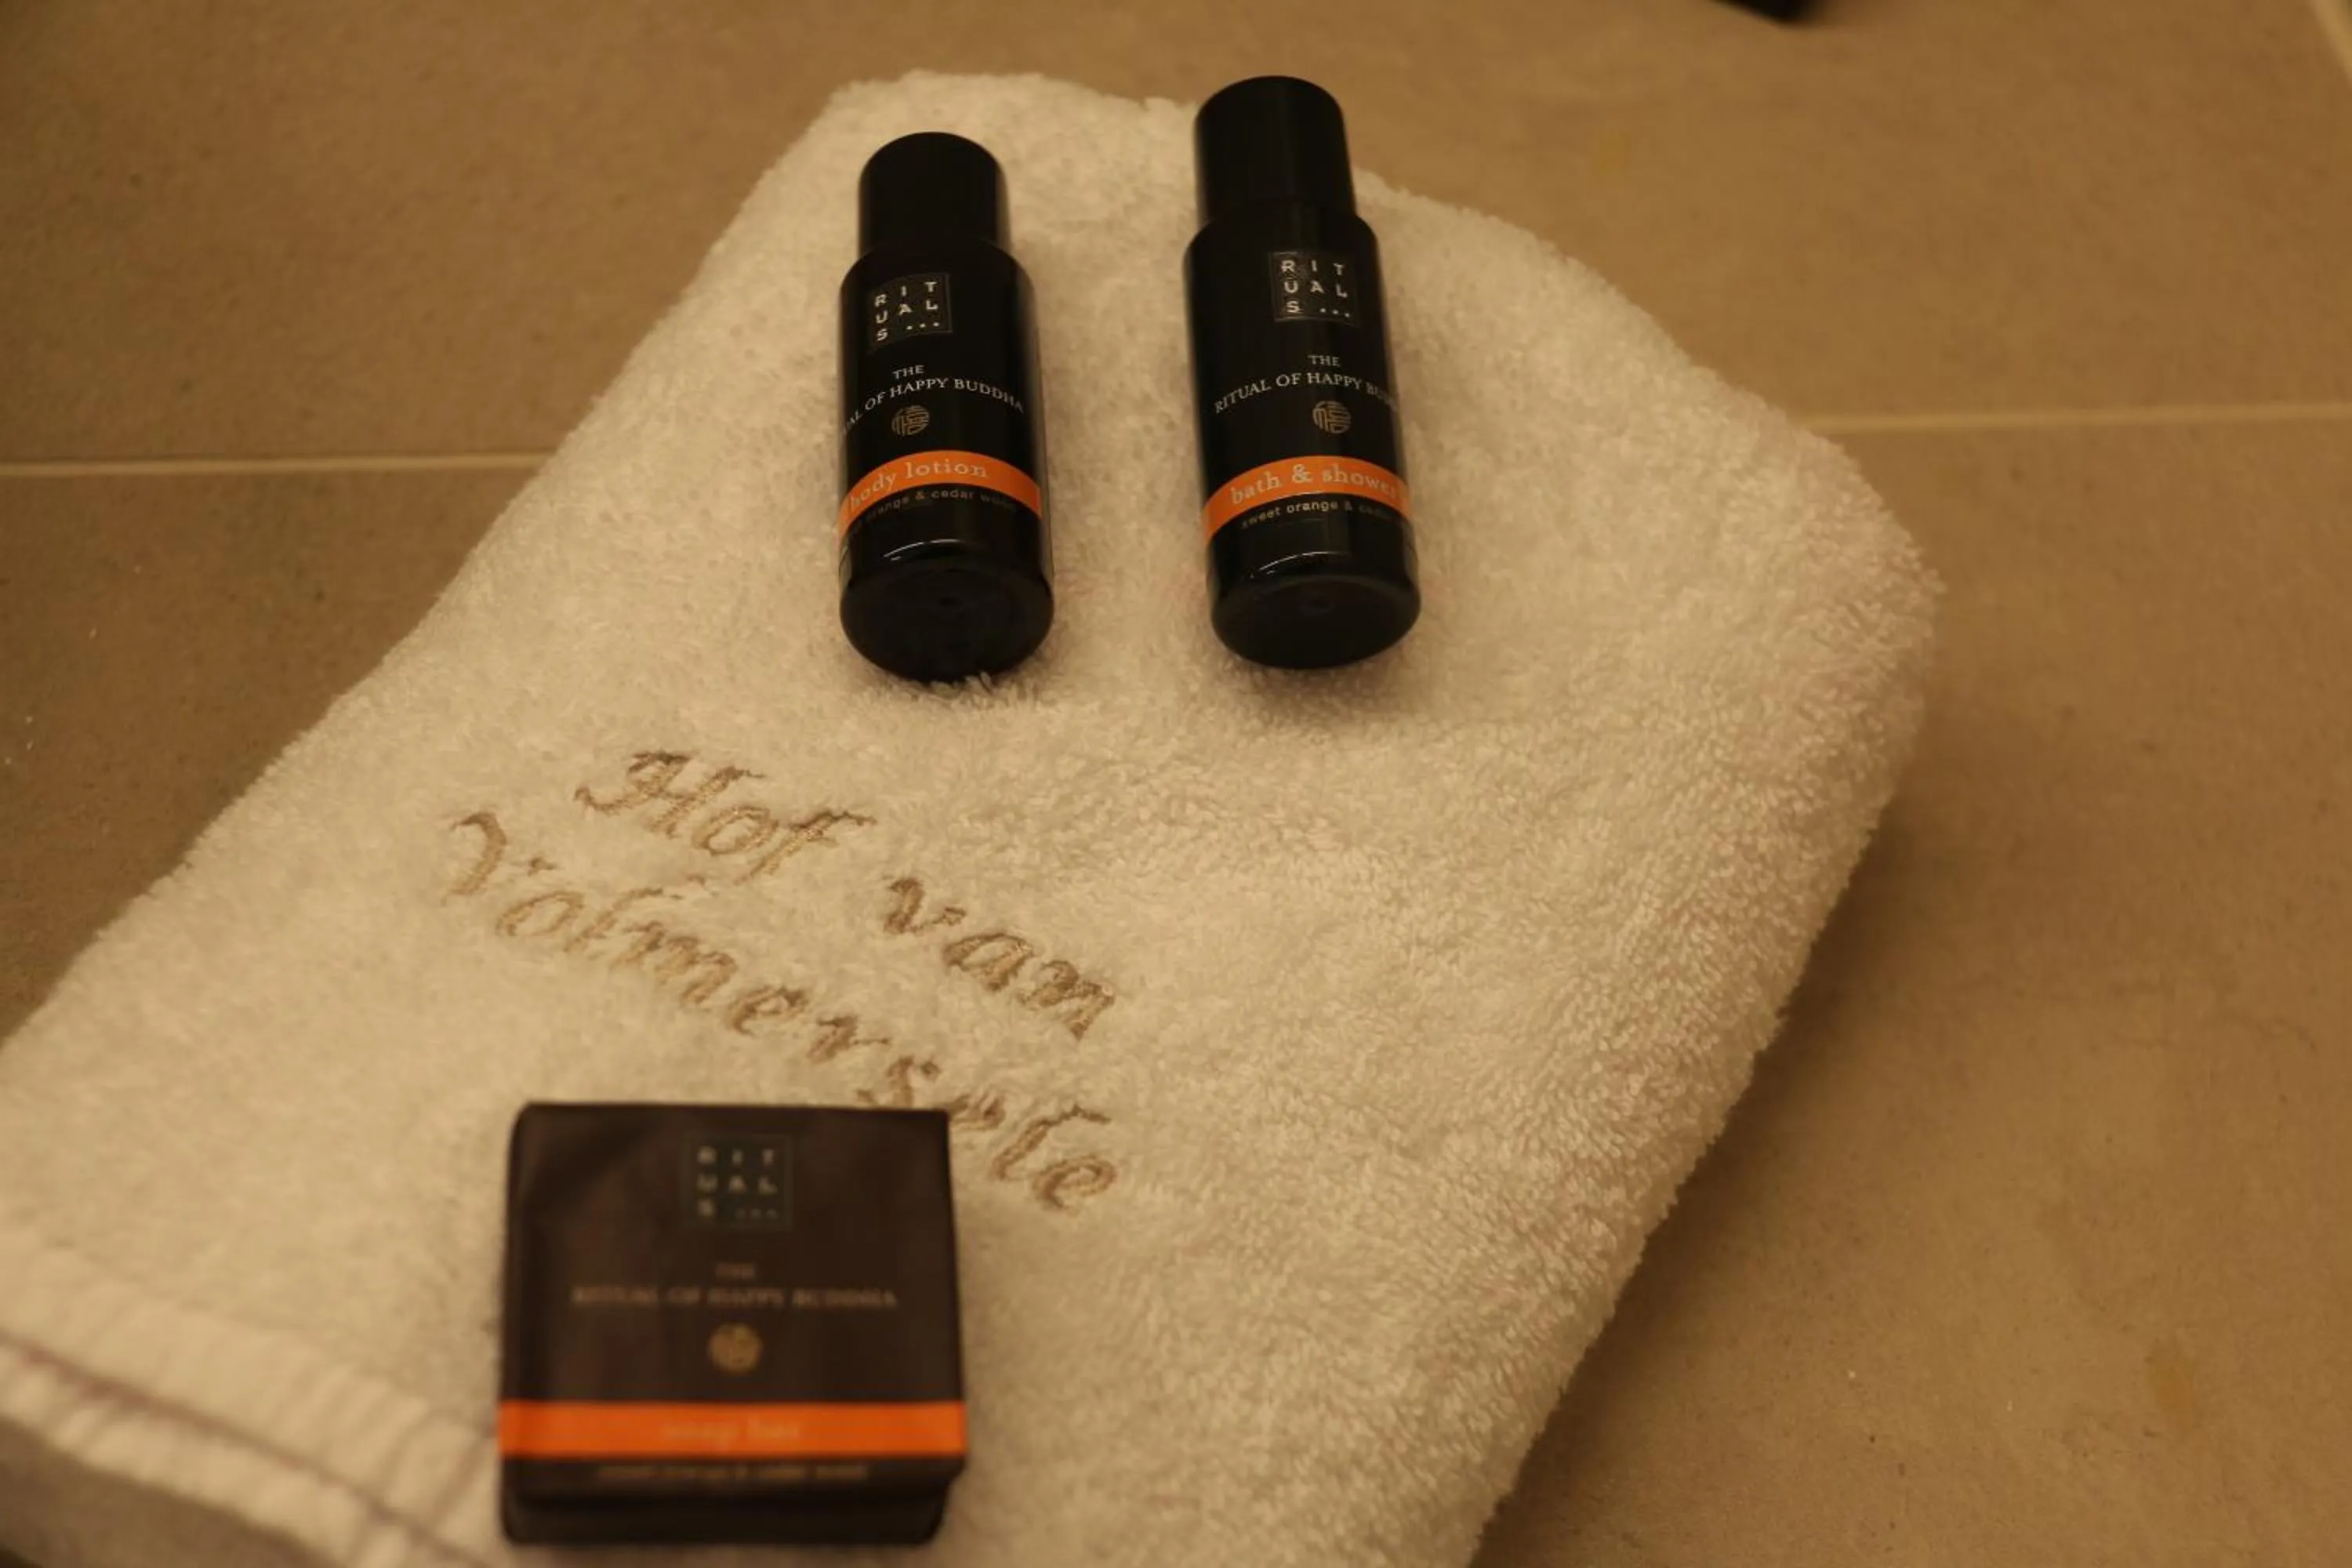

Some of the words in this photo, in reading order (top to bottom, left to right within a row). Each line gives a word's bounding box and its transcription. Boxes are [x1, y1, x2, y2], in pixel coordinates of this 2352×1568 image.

[1308, 354, 1340, 367] THE
[892, 365, 924, 379] THE
[865, 391, 886, 410] OF
[889, 378, 949, 398] HAPPY
[954, 379, 1025, 415] BUDDHA
[1214, 379, 1271, 414] RITUAL
[1276, 372, 1301, 387] OF
[1307, 372, 1362, 390] HAPPY
[905, 459, 989, 479] lotion
[1230, 470, 1283, 506] bath
[1291, 463, 1313, 484] &
[915, 490, 926, 500] &
[1287, 499, 1338, 512] orange
[882, 877, 1116, 1041] van
